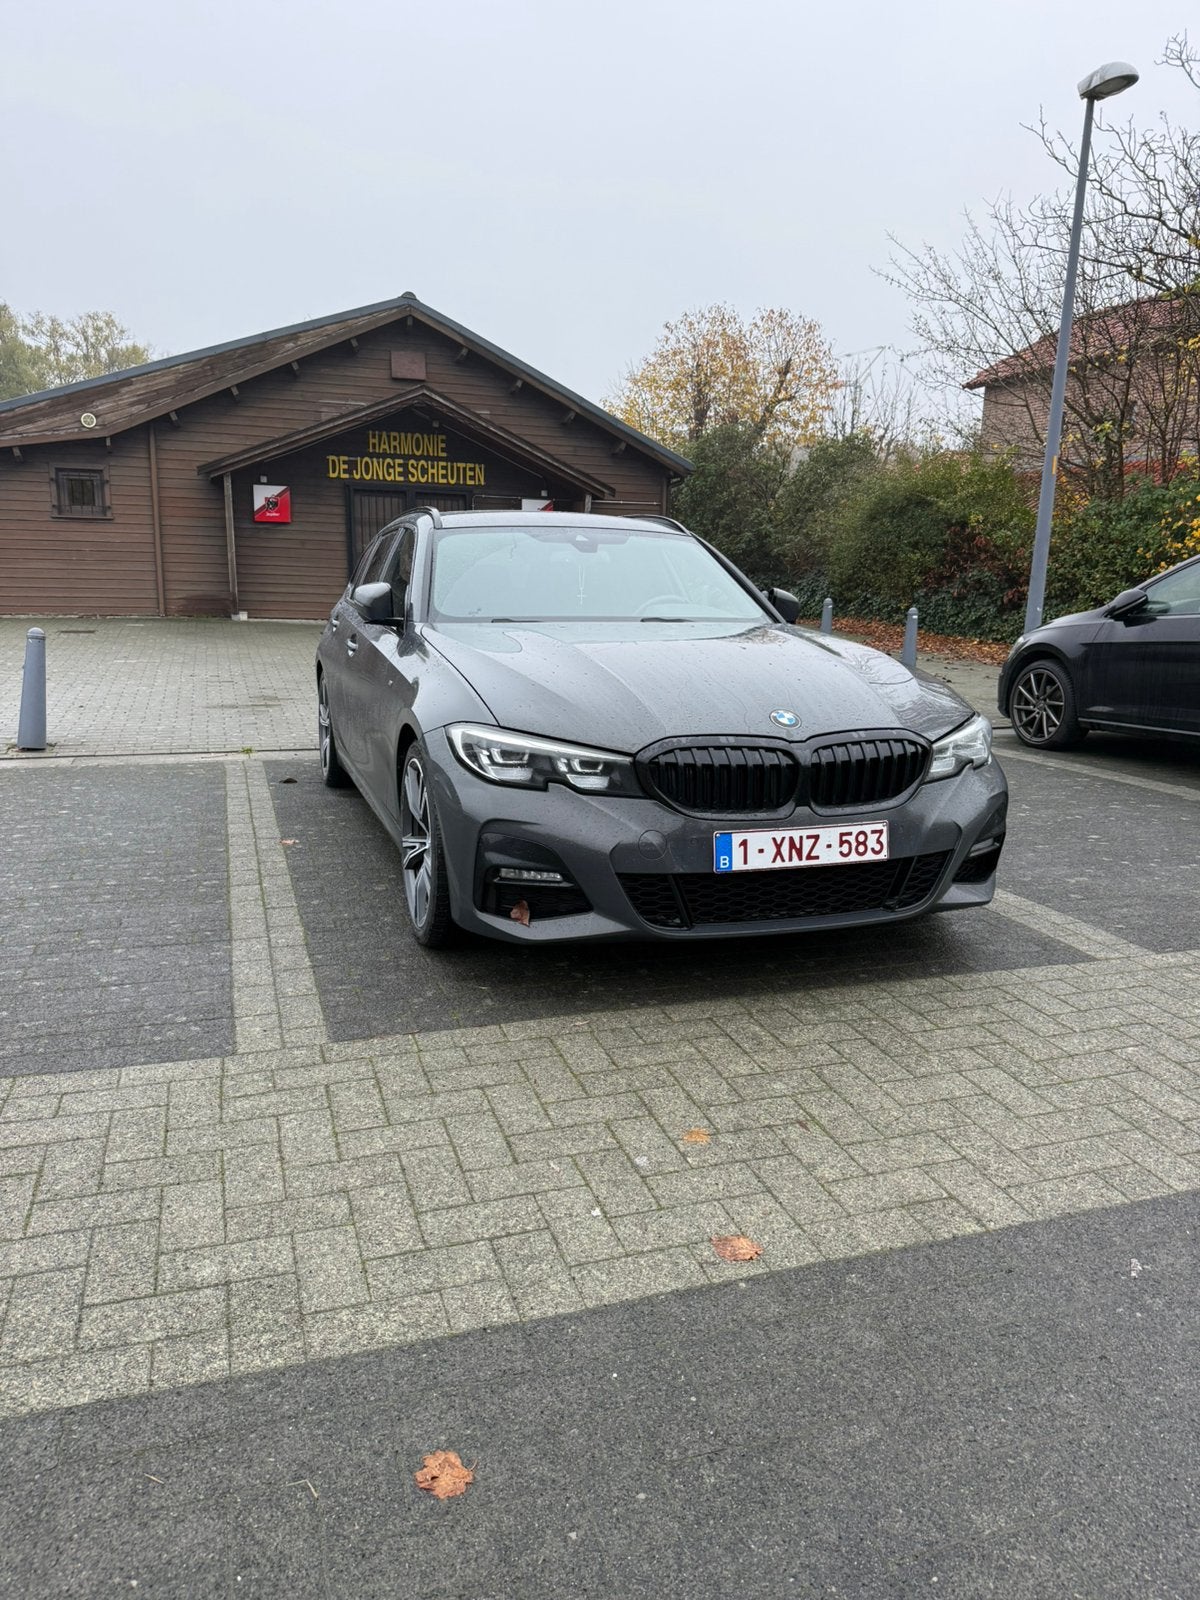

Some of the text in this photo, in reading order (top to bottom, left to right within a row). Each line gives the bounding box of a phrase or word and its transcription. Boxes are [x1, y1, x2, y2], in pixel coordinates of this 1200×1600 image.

[368, 430, 447, 457] HARMONIE
[327, 455, 485, 486] DE JONGE SCHEUTEN
[720, 855, 730, 868] B
